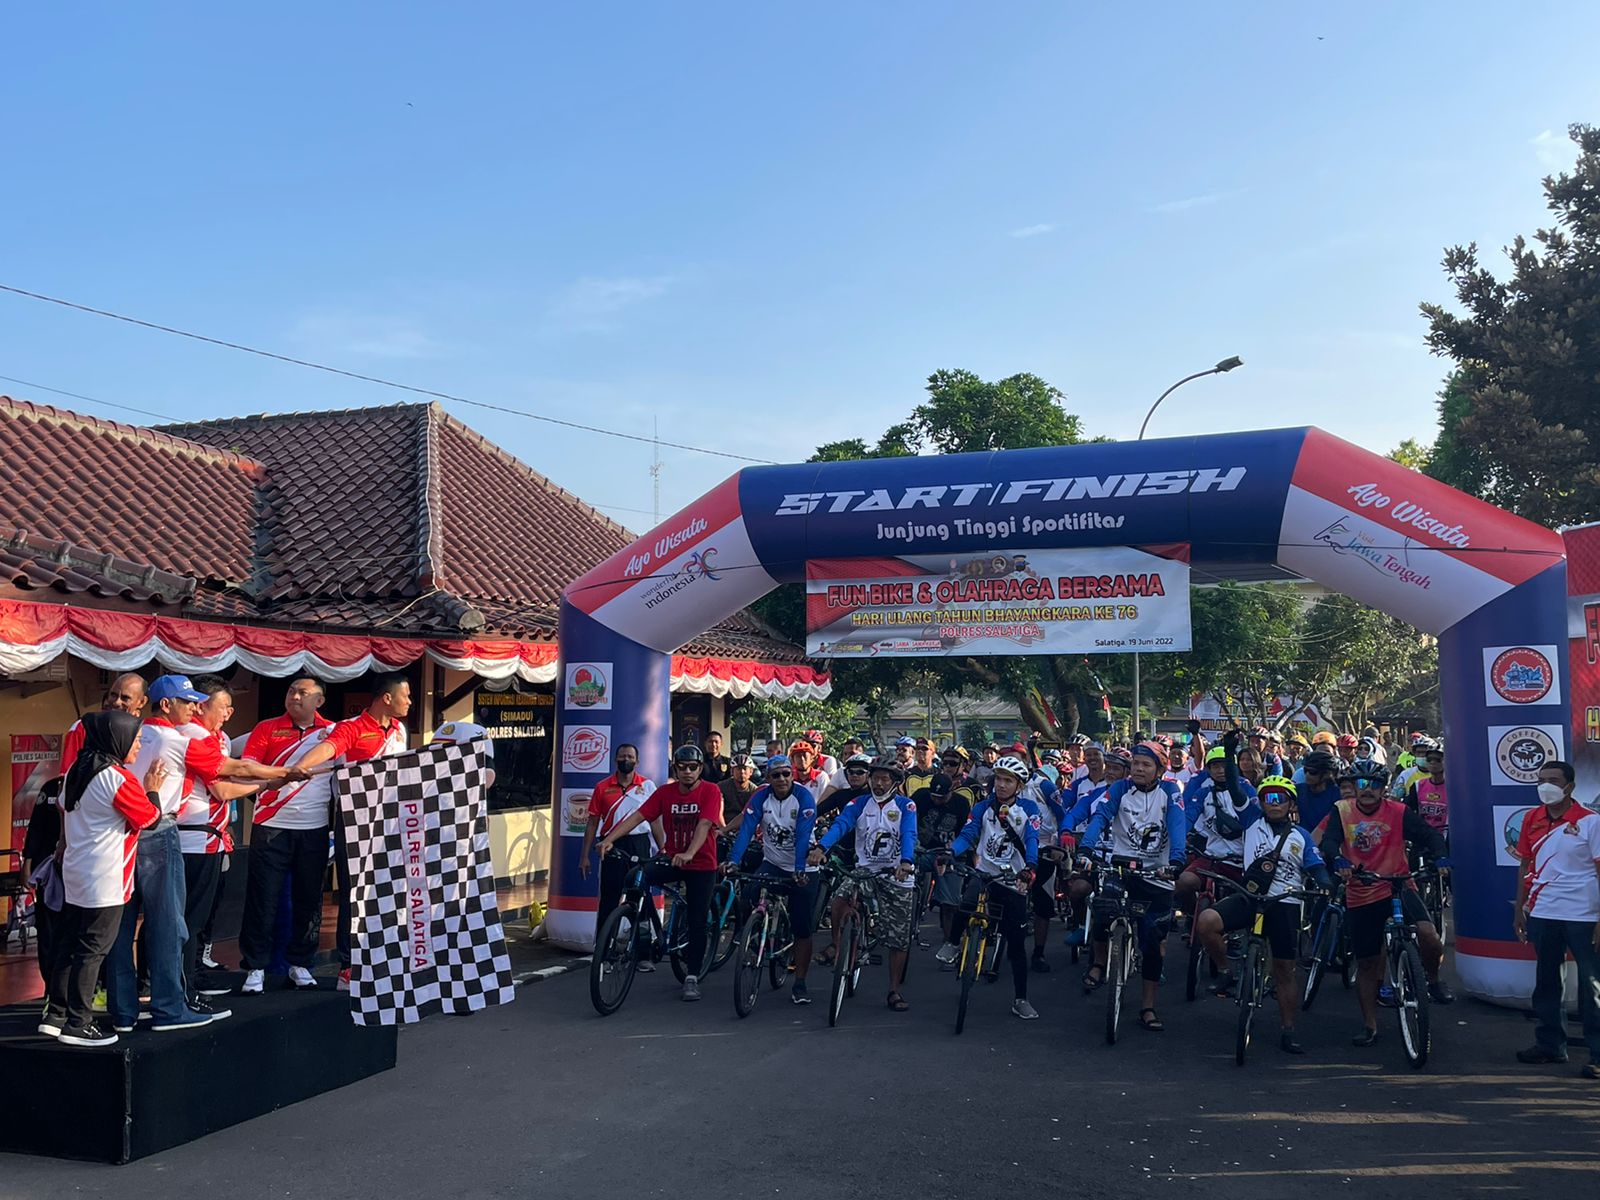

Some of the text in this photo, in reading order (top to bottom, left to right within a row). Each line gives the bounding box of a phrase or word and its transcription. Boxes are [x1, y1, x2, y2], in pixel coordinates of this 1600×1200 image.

[877, 512, 1125, 542] Junjung Tinggi Sportifitas
[1347, 482, 1471, 549] Ayo Wisata
[624, 518, 708, 576] Ayo Wisata
[1383, 554, 1431, 589] Tengah
[645, 574, 696, 609] indonesia
[828, 574, 1165, 608] FUN BIKE & OLAHRAGA BERSAMA
[852, 605, 1137, 626] HARI ULANG TAHUN BHAYANGKARA KE 76
[939, 624, 1041, 638] POLRES SALATIGA
[1128, 638, 1137, 646] 19
[1138, 638, 1153, 646] Juni
[1155, 637, 1174, 645] 2022
[501, 710, 533, 722] (SIMADU)
[514, 725, 546, 737] SALATIGA
[1506, 731, 1541, 742] COFFEE
[671, 803, 700, 814] R.E.D.
[404, 803, 428, 968] POLRES SALATIGA
